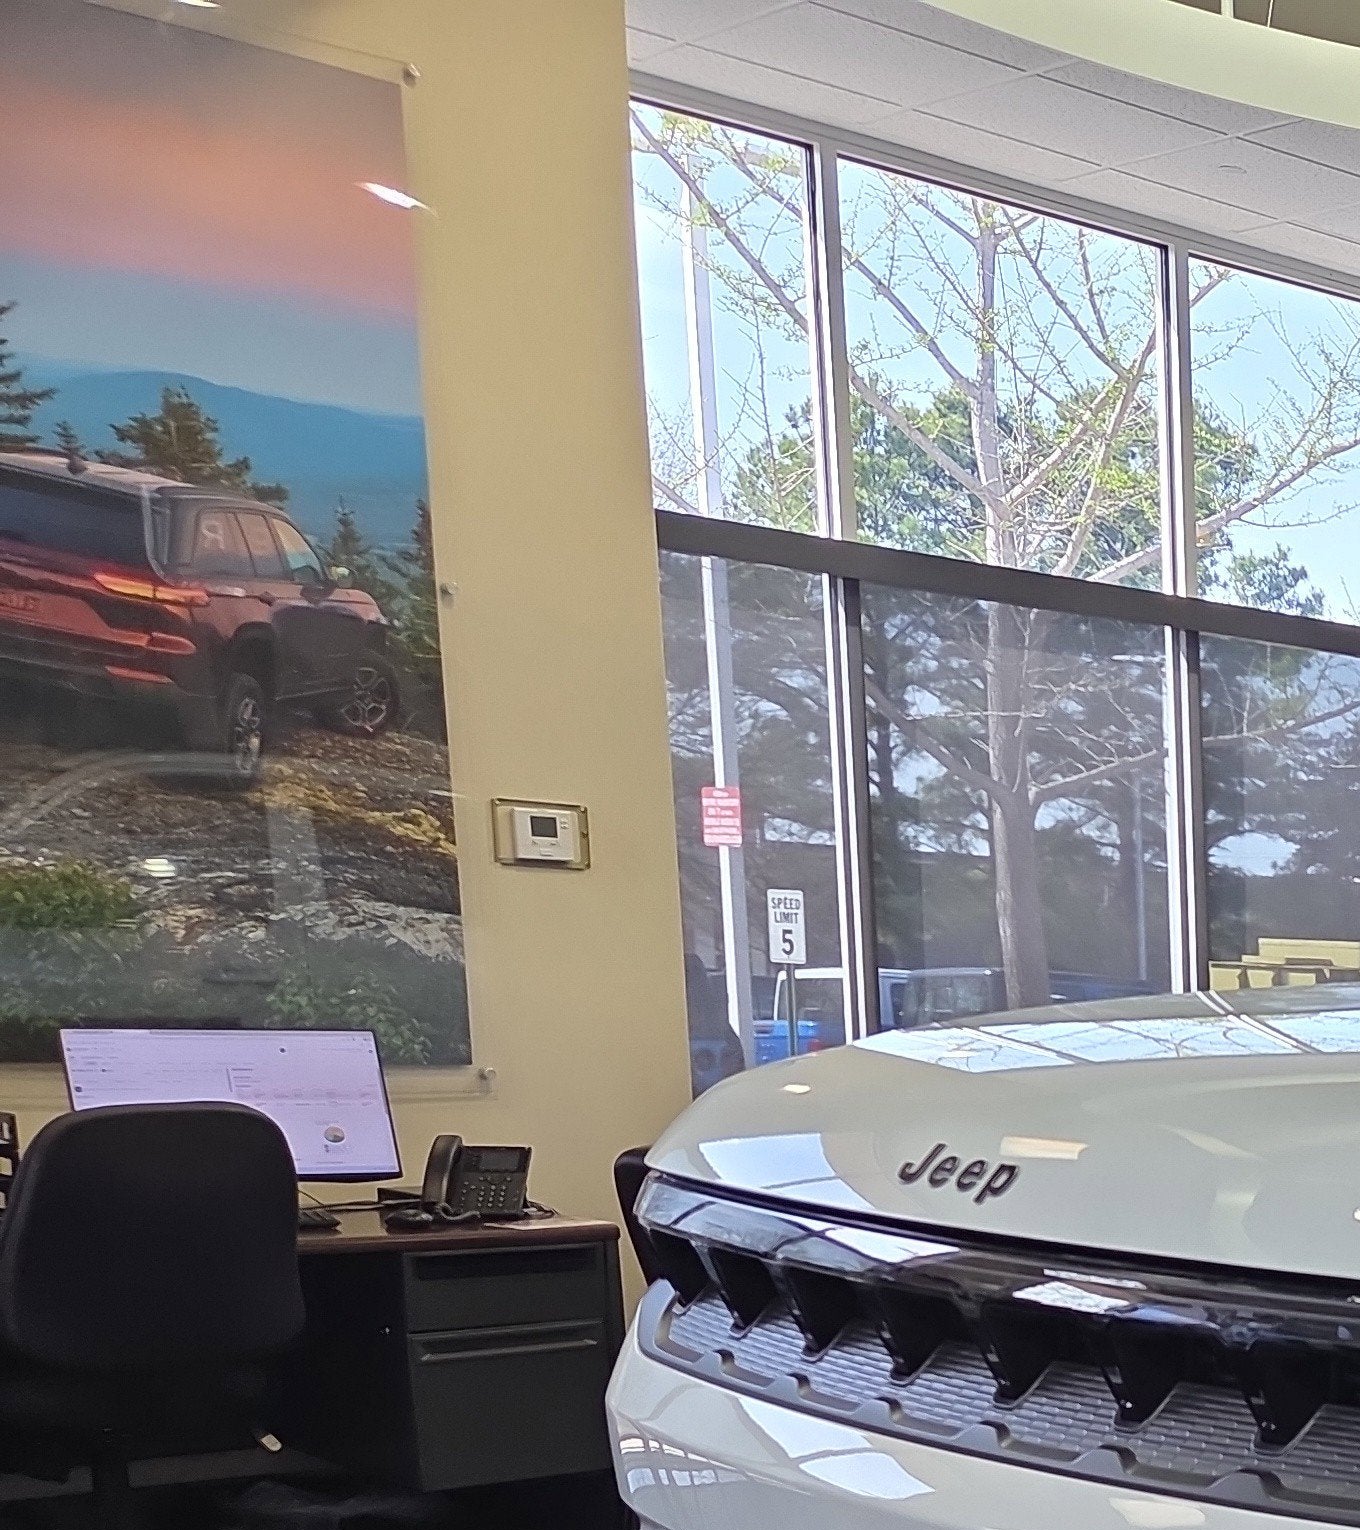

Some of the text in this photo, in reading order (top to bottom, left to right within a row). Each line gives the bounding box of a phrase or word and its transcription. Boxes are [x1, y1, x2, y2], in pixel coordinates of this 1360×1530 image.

[770, 896, 801, 910] SPEED
[773, 911, 800, 924] LIMIT
[781, 929, 795, 956] 5
[898, 1143, 1020, 1205] Jeep
